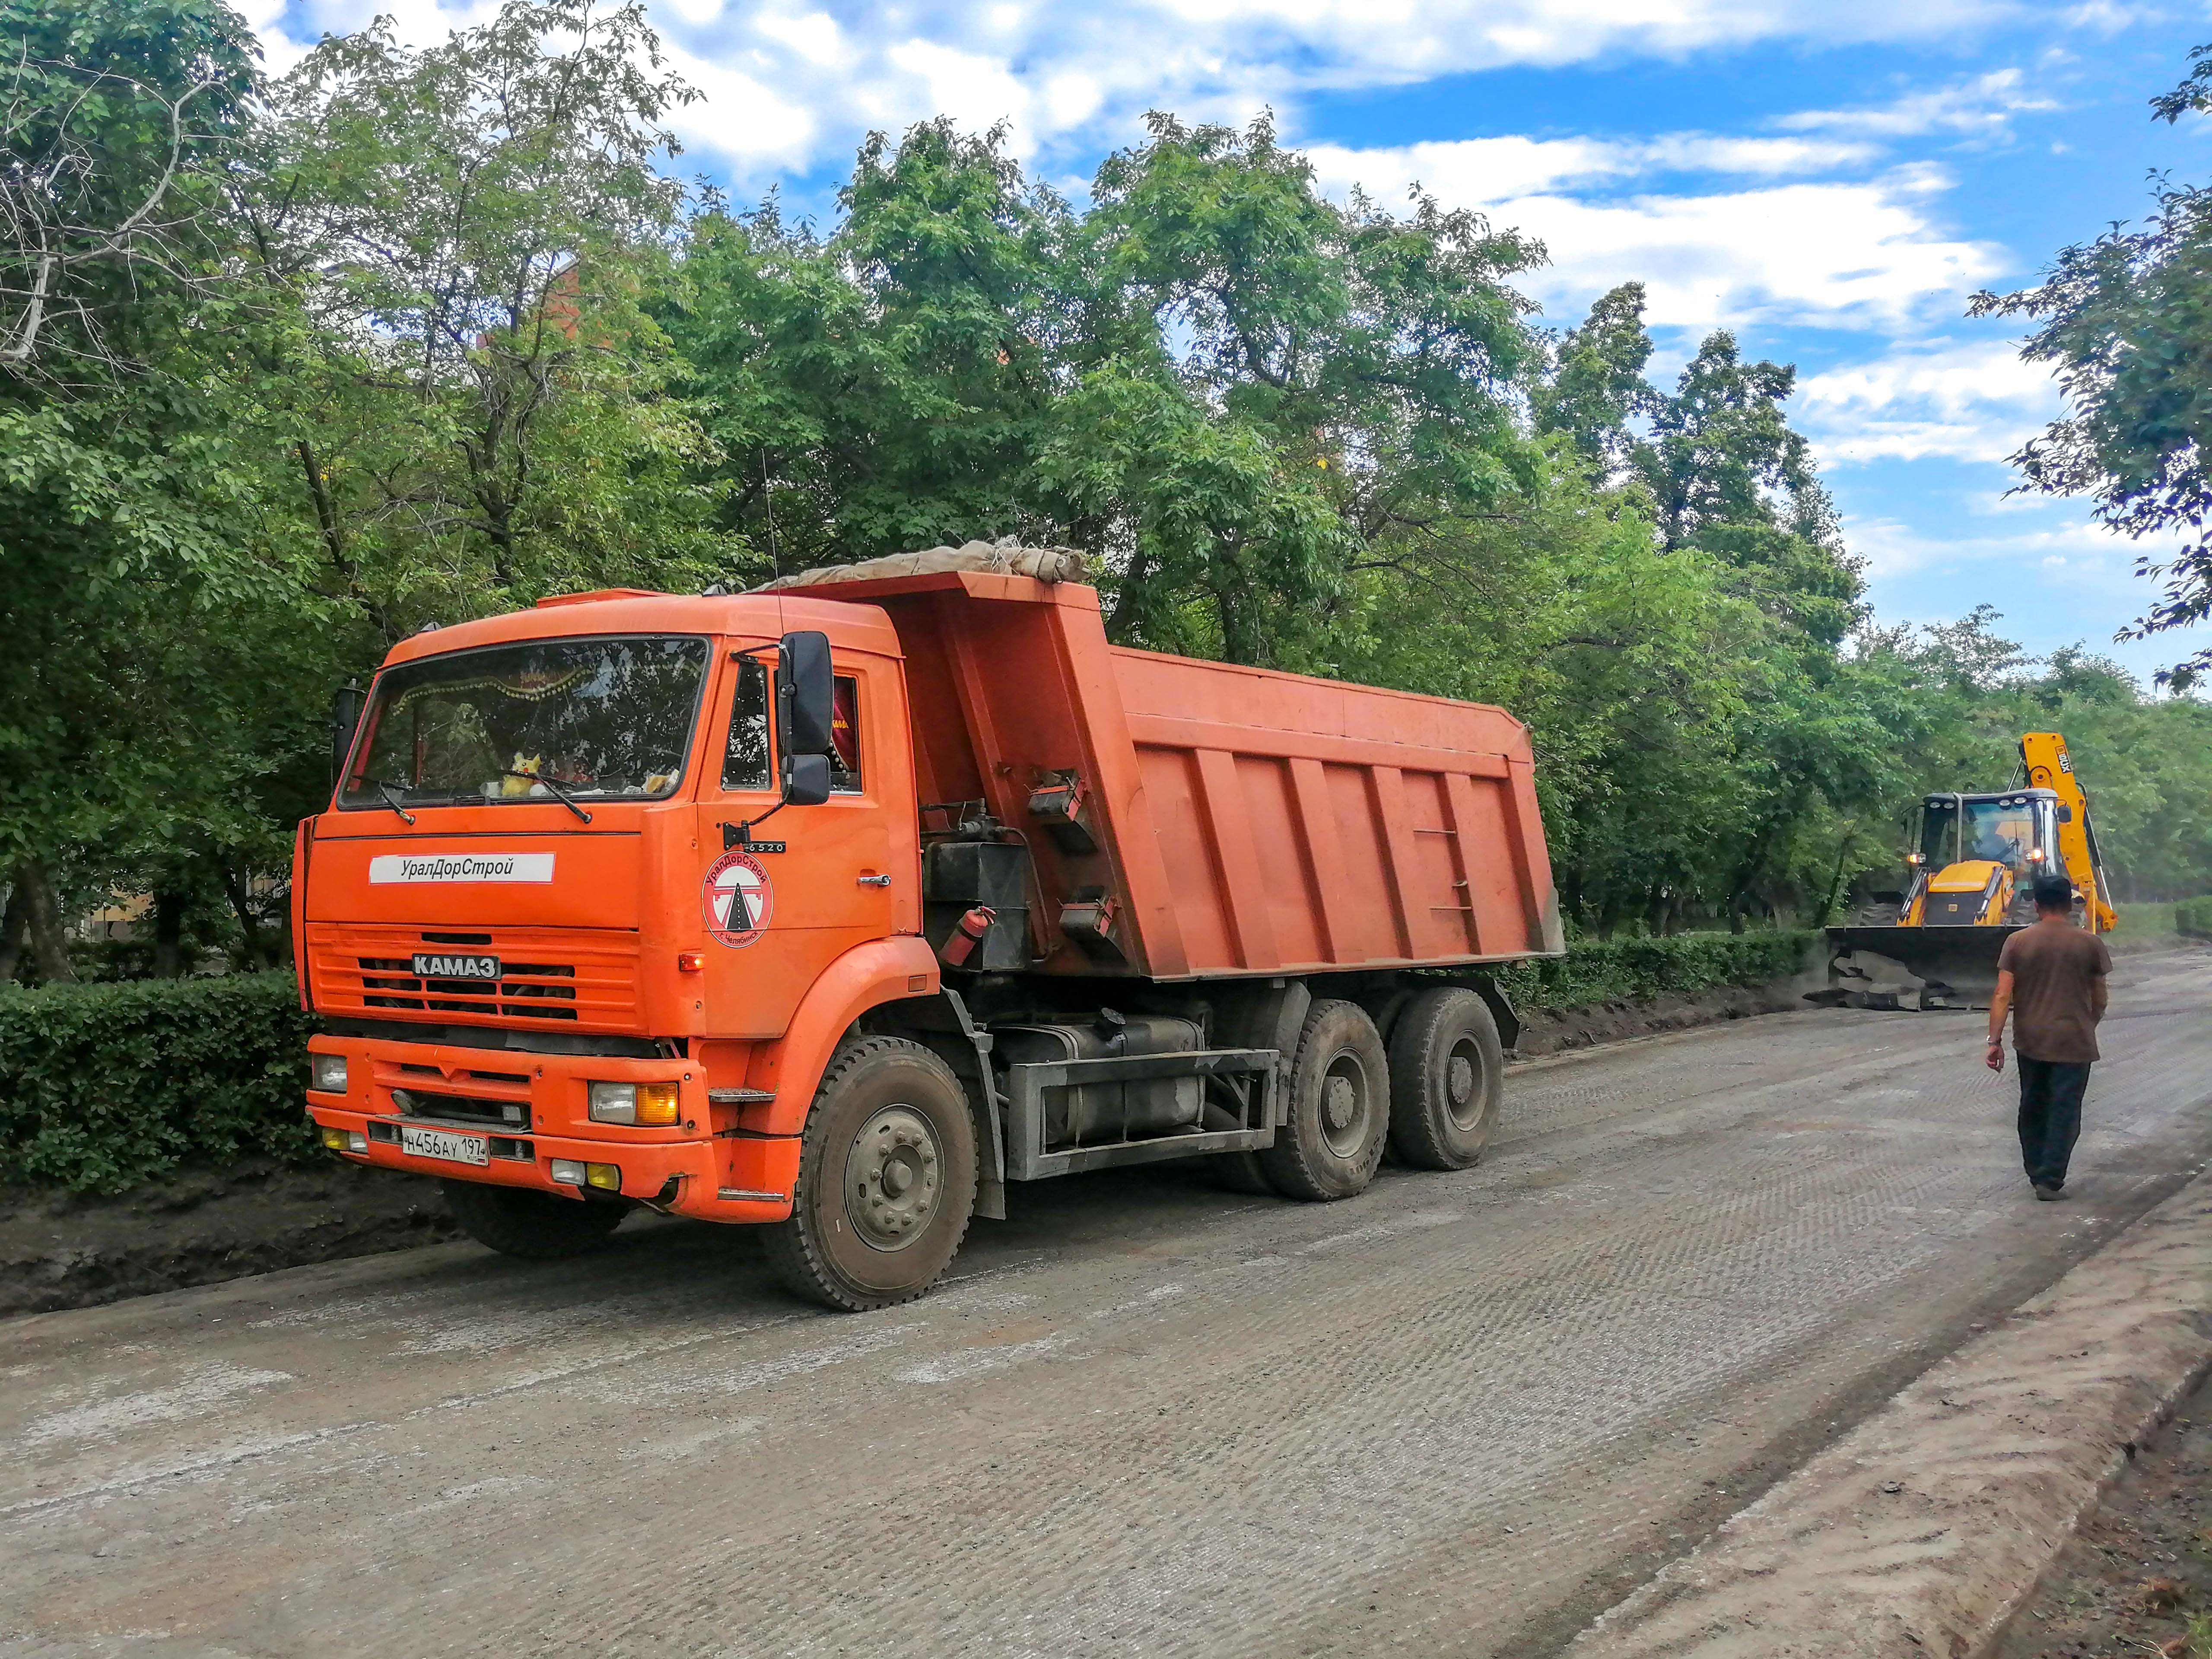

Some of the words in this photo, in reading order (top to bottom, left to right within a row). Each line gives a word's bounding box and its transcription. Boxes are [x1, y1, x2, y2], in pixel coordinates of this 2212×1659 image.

[401, 858, 513, 880] УралДорСтрой
[706, 855, 768, 886] УралДорСтрой
[725, 931, 758, 944] Челябинск
[415, 957, 495, 978] КАМАЗ
[462, 1138, 480, 1155] 197
